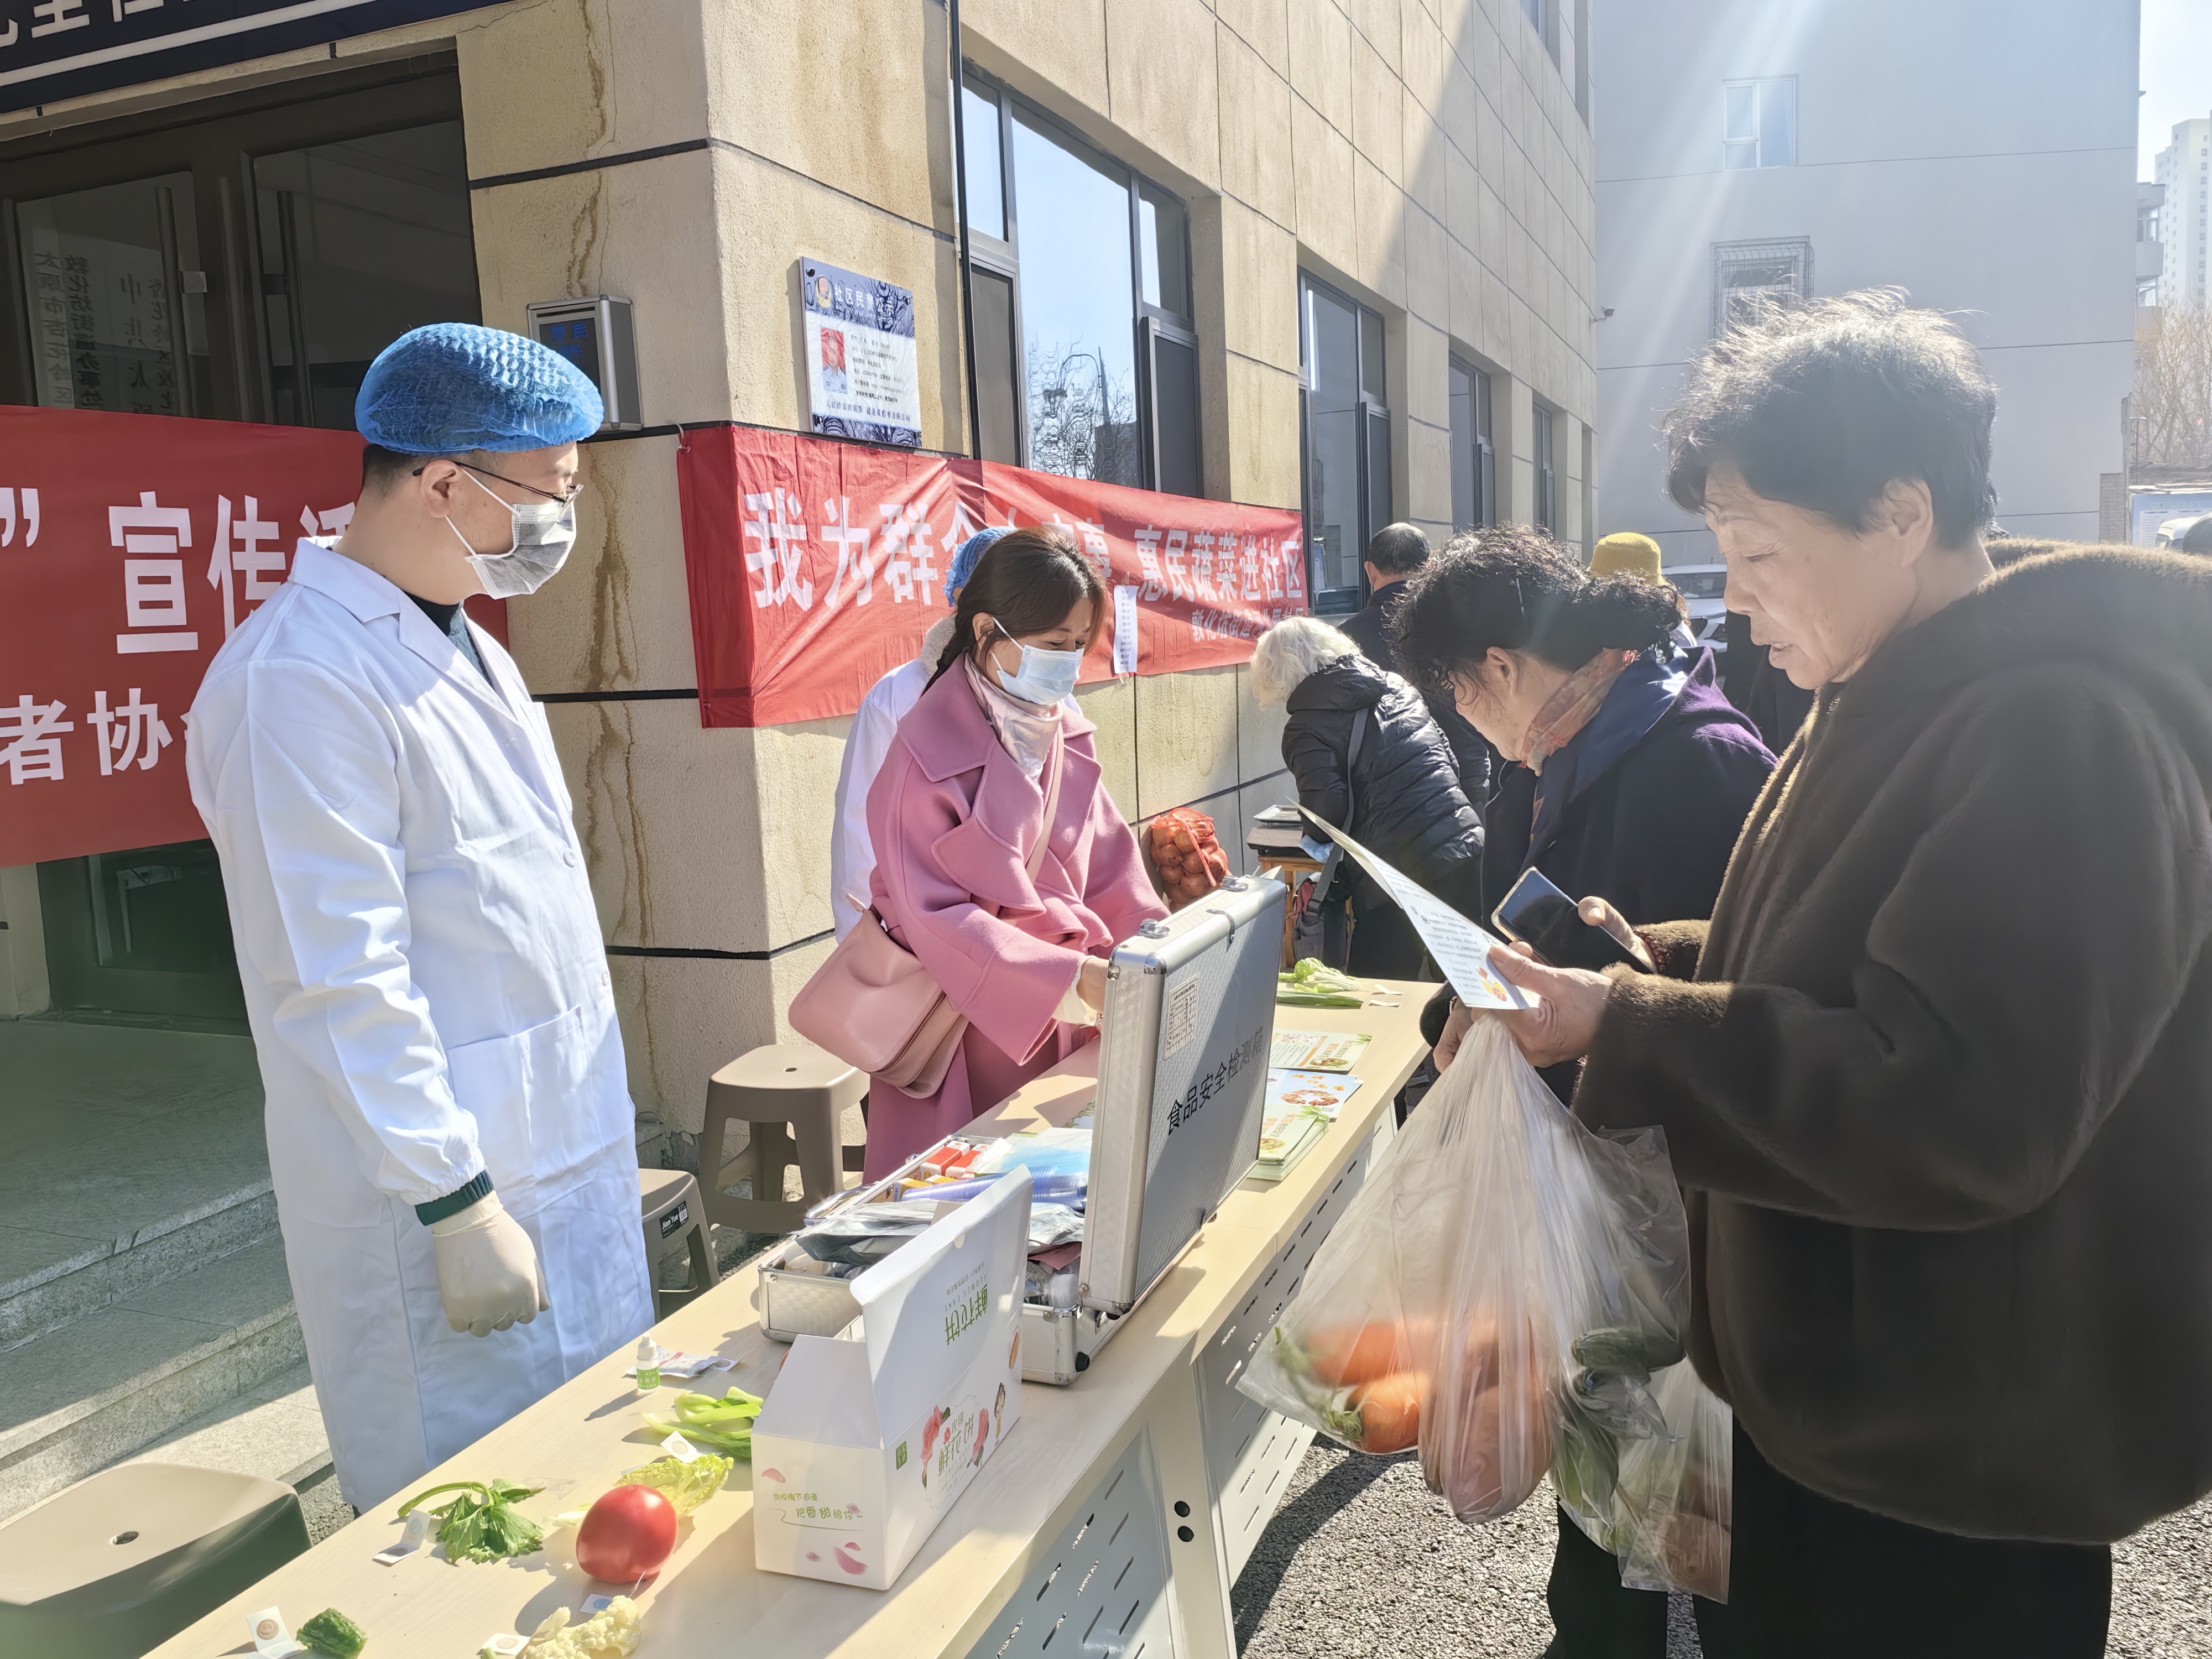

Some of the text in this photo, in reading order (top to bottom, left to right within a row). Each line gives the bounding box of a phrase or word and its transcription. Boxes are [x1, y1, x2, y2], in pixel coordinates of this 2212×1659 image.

[834, 284, 894, 317] 社区民警公示
[1134, 524, 1302, 603] 惠民蔬菜进社区
[0, 688, 191, 785] 者协
[1167, 1026, 1264, 1136] 食品安全检测箱
[945, 1284, 989, 1346] 鲜花饼
[938, 1412, 974, 1477] 鲜花饼
